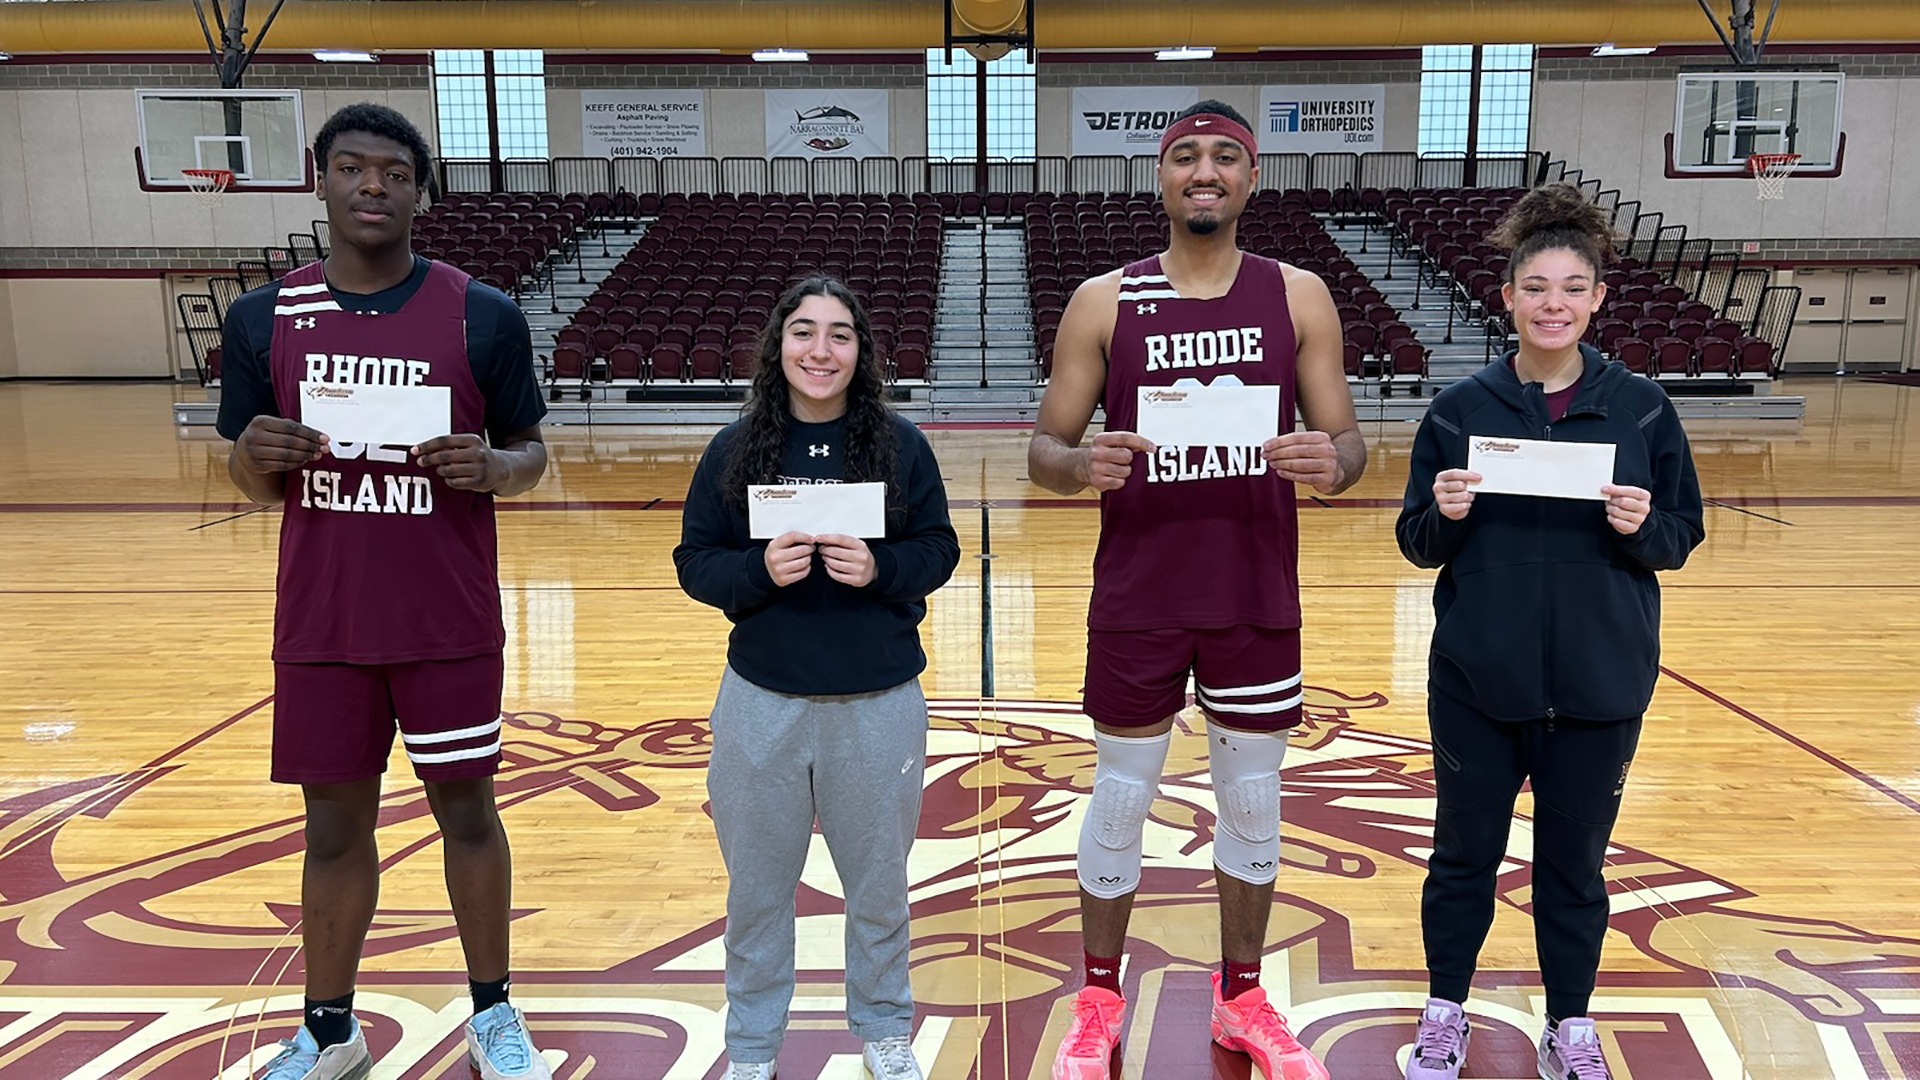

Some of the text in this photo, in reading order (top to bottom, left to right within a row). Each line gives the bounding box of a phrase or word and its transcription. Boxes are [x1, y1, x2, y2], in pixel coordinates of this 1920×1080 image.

[585, 103, 699, 112] KEEFE GENERAL SERVICE
[1301, 100, 1375, 115] UNIVERSITY
[1083, 111, 1182, 130] DETROI
[1301, 116, 1375, 132] ORTHOPEDICS
[789, 124, 865, 135] NARRAGANSETT BAY
[610, 147, 678, 156] (401) 942-1904
[1145, 327, 1263, 371] RHODE
[305, 353, 430, 387] RHODE
[1147, 445, 1267, 483] ISLAND
[301, 469, 433, 515] ISLAND
